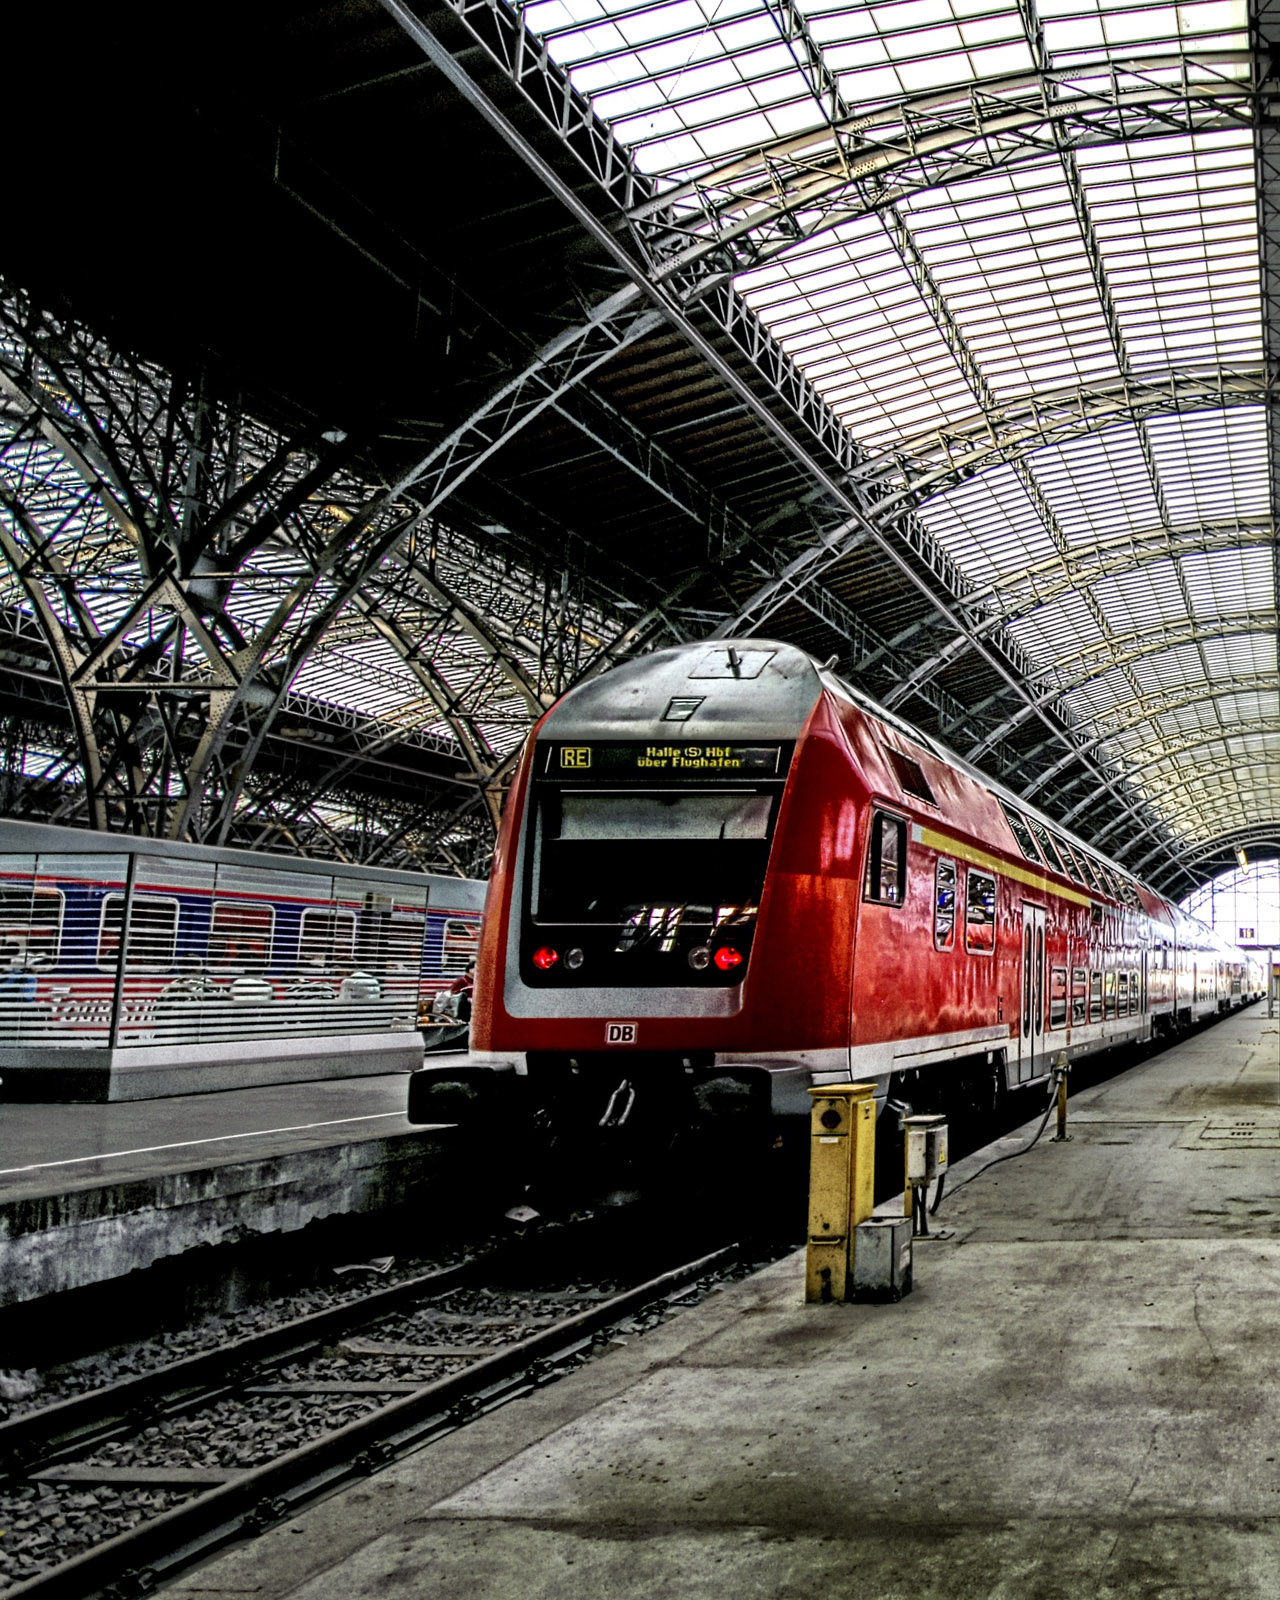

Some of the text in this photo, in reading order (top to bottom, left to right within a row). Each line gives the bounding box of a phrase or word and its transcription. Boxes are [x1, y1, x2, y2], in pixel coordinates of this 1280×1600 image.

[564, 749, 588, 766] RE
[646, 747, 731, 758] Halle (S) Hbf
[637, 757, 740, 769] über Flughafen
[608, 1024, 635, 1042] DB
